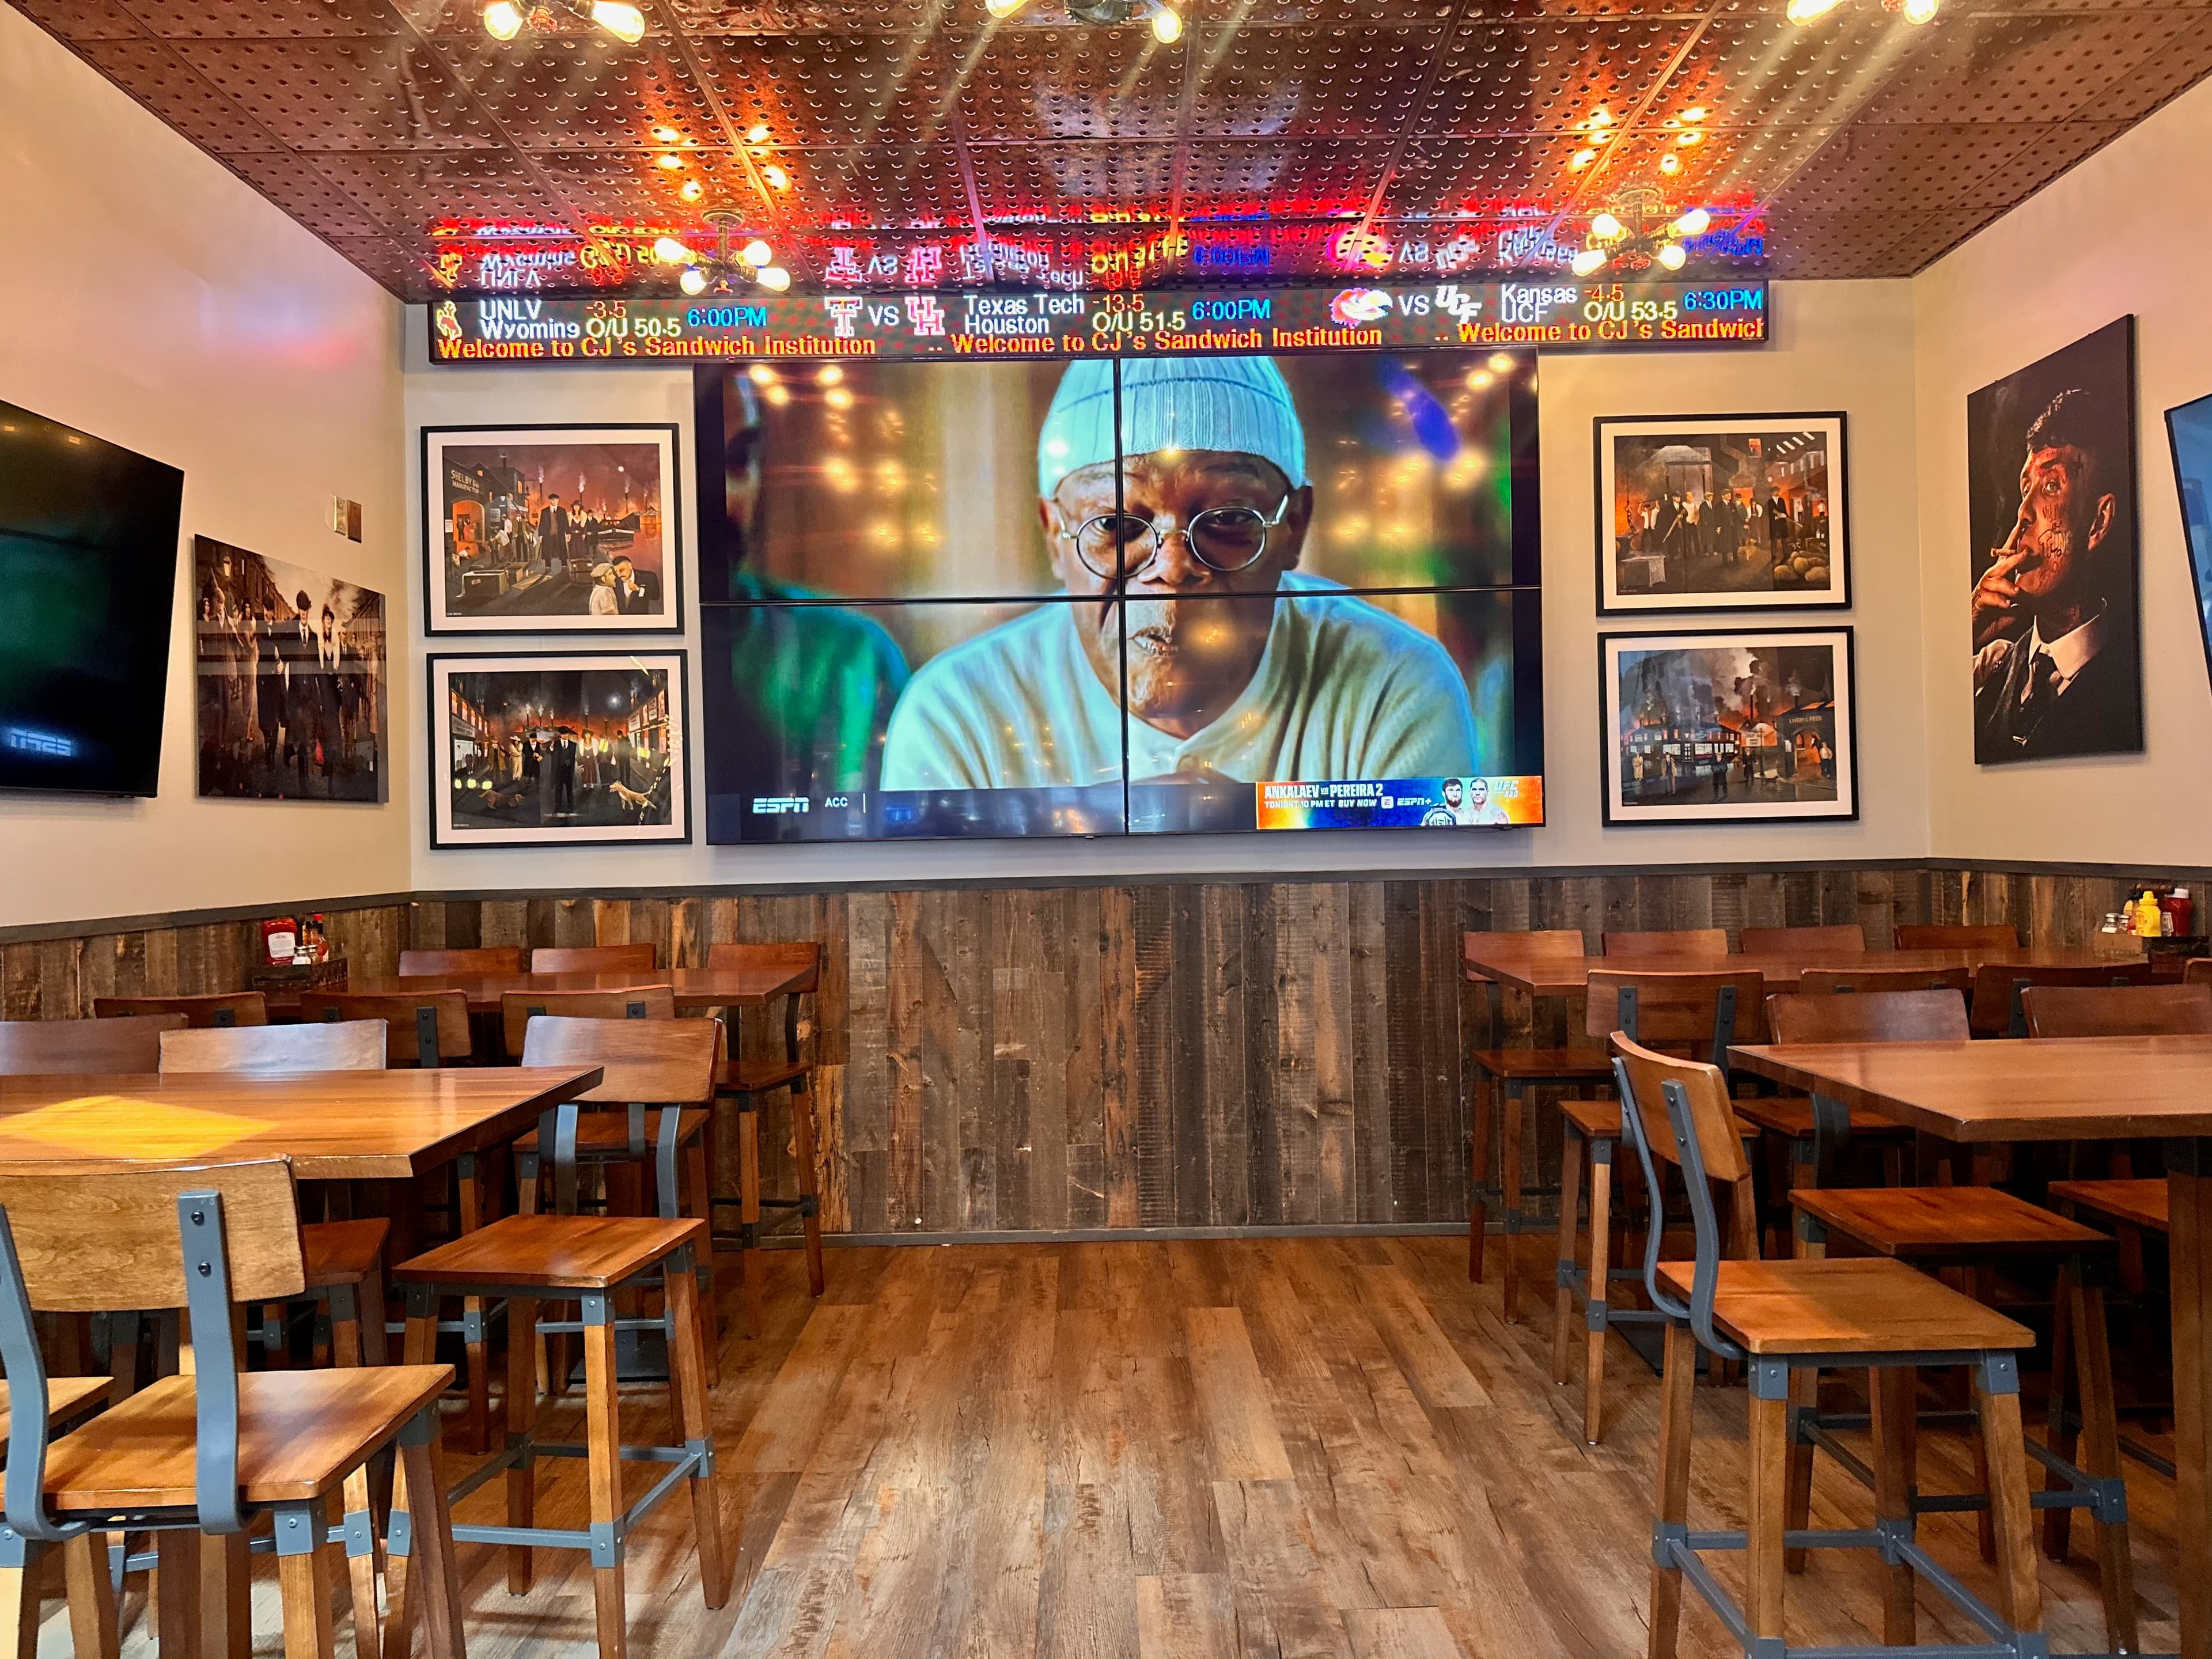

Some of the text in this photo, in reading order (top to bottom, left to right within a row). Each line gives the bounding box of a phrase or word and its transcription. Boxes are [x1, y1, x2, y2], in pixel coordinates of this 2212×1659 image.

[1502, 283, 1624, 304] Kansas -4.5
[1684, 289, 1763, 311] 6:30PM
[479, 300, 626, 320] UNLV -3.5
[963, 293, 1145, 316] Texas Tech -13.5
[1192, 298, 1271, 321] 6:00PM
[1398, 294, 1430, 316] VS
[1502, 301, 1677, 323] UCF O/U 53.5
[687, 306, 767, 328] 6:00PM
[868, 305, 900, 326] VS
[964, 312, 1186, 334] Houston O/U 51.5
[480, 319, 682, 339] Wyoming O/U 50.5
[1457, 323, 1562, 343] Welcome
[1568, 323, 1591, 341] to
[1598, 320, 1652, 340] CJ's
[438, 335, 876, 358] Welcome to CJ's Sandwich Institution
[950, 327, 1382, 353] Welcome to CJ's Sandwich Institution
[451, 470, 472, 485] SHELBY
[1264, 785, 1319, 798] ANKALAEV
[1330, 783, 1376, 797] PEREIRA
[1376, 783, 1383, 796] 2
[1493, 780, 1518, 791] UFC
[752, 797, 809, 813] ESPN
[825, 797, 849, 808] ACC
[1264, 800, 1299, 809] TONIGHT
[1301, 800, 1309, 808] 10
[1310, 800, 1324, 808] PM
[1338, 799, 1355, 808] BUY
[1357, 798, 1377, 806] NOW
